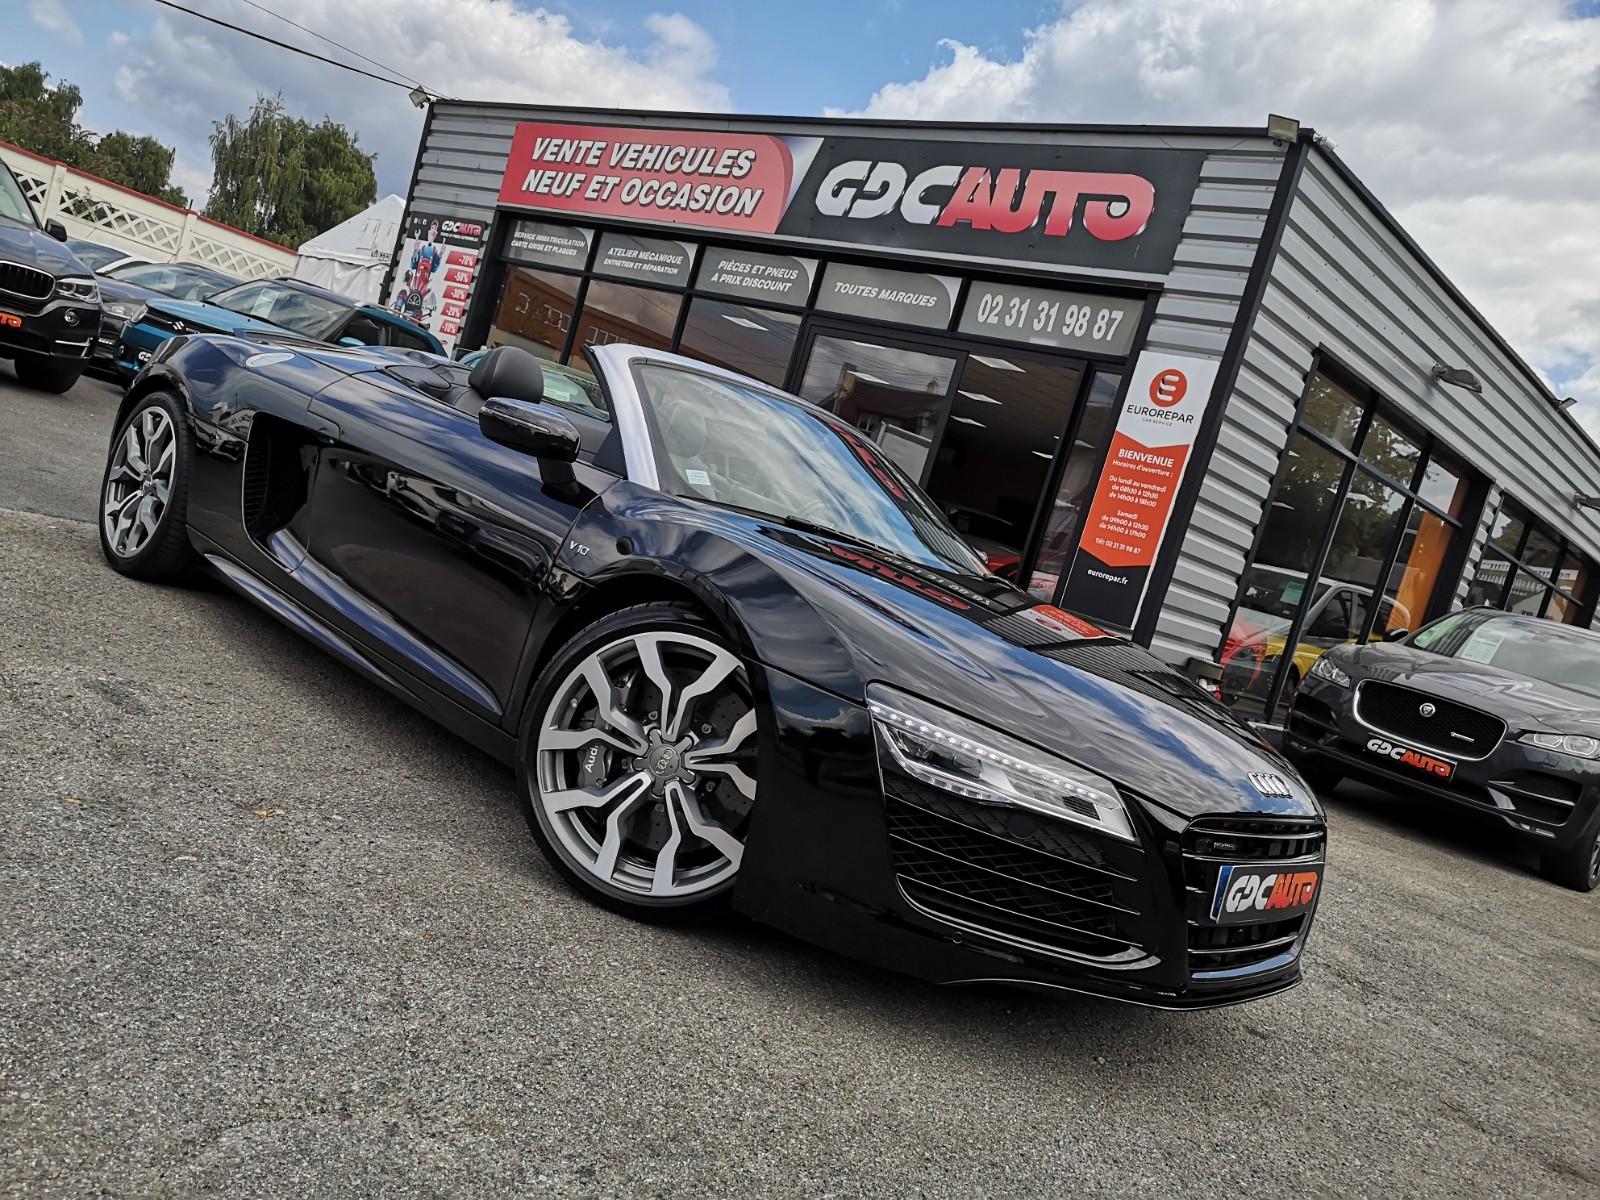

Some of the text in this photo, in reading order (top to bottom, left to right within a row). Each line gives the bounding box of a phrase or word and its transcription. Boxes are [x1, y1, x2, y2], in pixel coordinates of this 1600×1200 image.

[531, 137, 757, 178] VENTE VEHICULES
[521, 169, 763, 217] NEUF ET OCCASION
[815, 160, 1155, 241] GDCAUTO
[511, 239, 577, 256] CARTE GRISE ET PLAQUES
[514, 231, 585, 248] SERVICE IMMATRICULATION
[607, 247, 684, 265] ATELIER MÉCANIQUE
[604, 258, 679, 275] ENTRETIEN ET RÉPARATION
[718, 259, 798, 280] PIÈCES ET PNEUS
[719, 273, 742, 285] PRIX
[742, 276, 792, 292] DISCOUNT
[834, 282, 937, 308] TOUTES MARQUES
[977, 293, 1125, 341] 02 31 31 98 87
[1126, 404, 1194, 424] EUROREPAR
[1118, 449, 1174, 467] BIENVENUE
[1112, 460, 1136, 470] Horaires
[1136, 464, 1170, 477] d'ouverture
[1118, 476, 1132, 485] lundi
[1140, 483, 1167, 493] vendredi
[1117, 493, 1134, 502] 14h00
[1142, 490, 1158, 499] 12h30
[1117, 510, 1138, 519] Samedi
[1107, 524, 1124, 534] 14h00
[1129, 530, 1147, 539] 17h00
[1109, 516, 1128, 526] 09h00
[1133, 521, 1149, 531] 12h30
[1126, 545, 1133, 553] 98
[1087, 568, 1128, 585] eurorepar.fr
[1366, 738, 1451, 777] GDCAUTO
[1226, 871, 1317, 912] GDCAUTO
